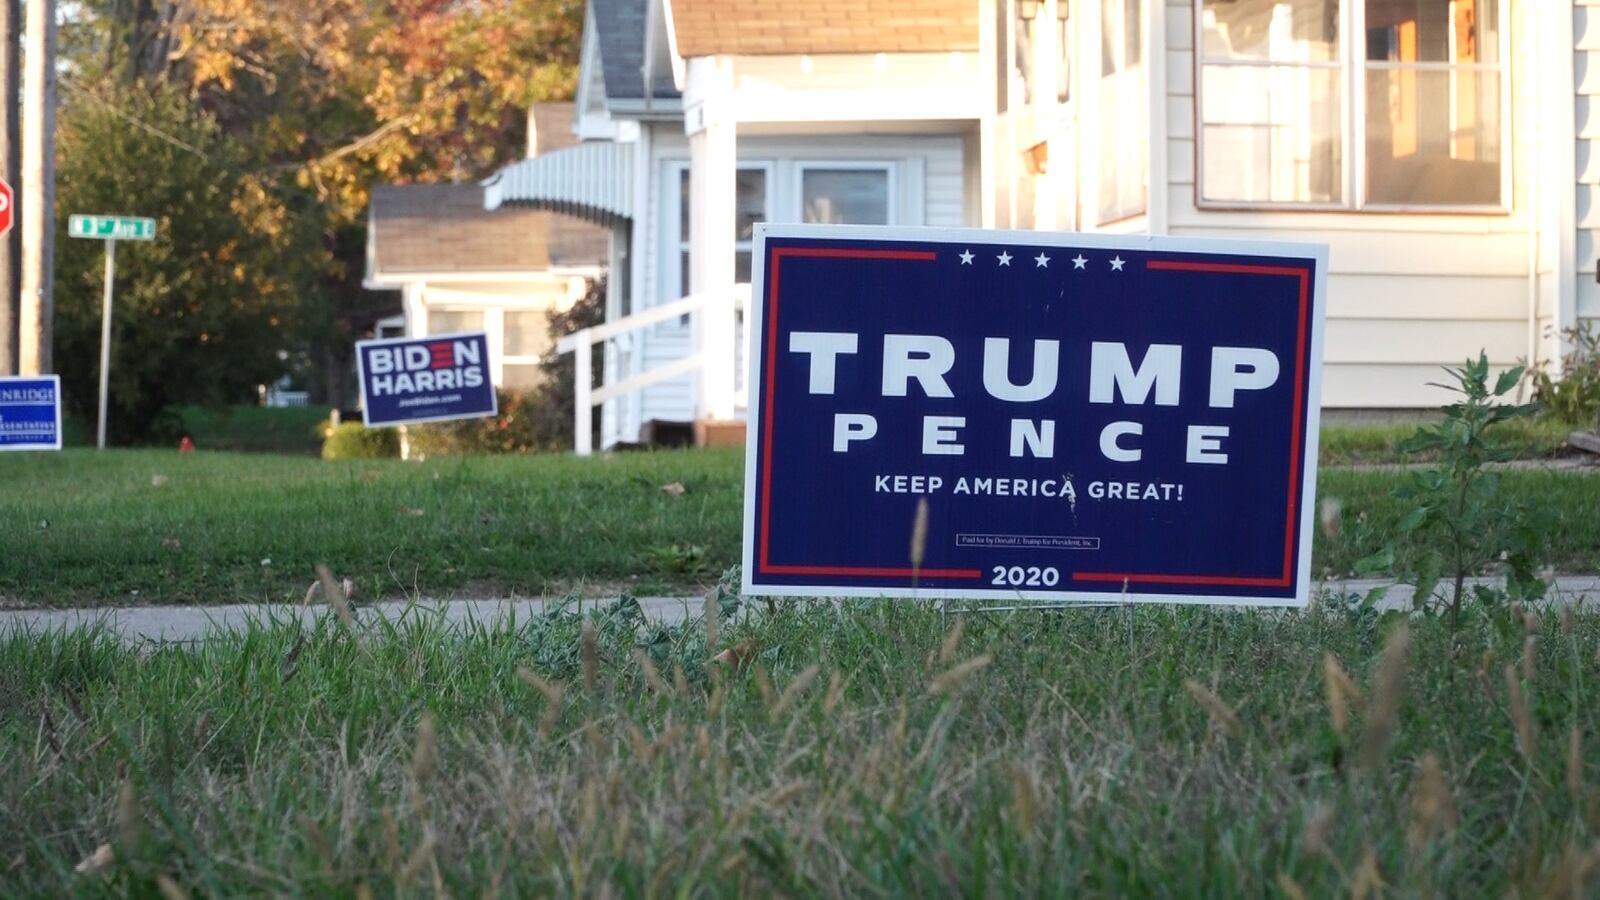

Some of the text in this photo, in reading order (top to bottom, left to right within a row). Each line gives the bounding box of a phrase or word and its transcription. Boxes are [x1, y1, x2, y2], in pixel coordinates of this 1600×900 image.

[368, 340, 481, 374] BIDEN
[790, 332, 1279, 407] TRUMP
[0, 388, 54, 401] NRIDGE
[372, 366, 483, 396] HARRIS
[834, 414, 1229, 464] PENCE
[876, 476, 1182, 500] KEEP AMERICA GREAT!
[992, 566, 1059, 586] 2020
